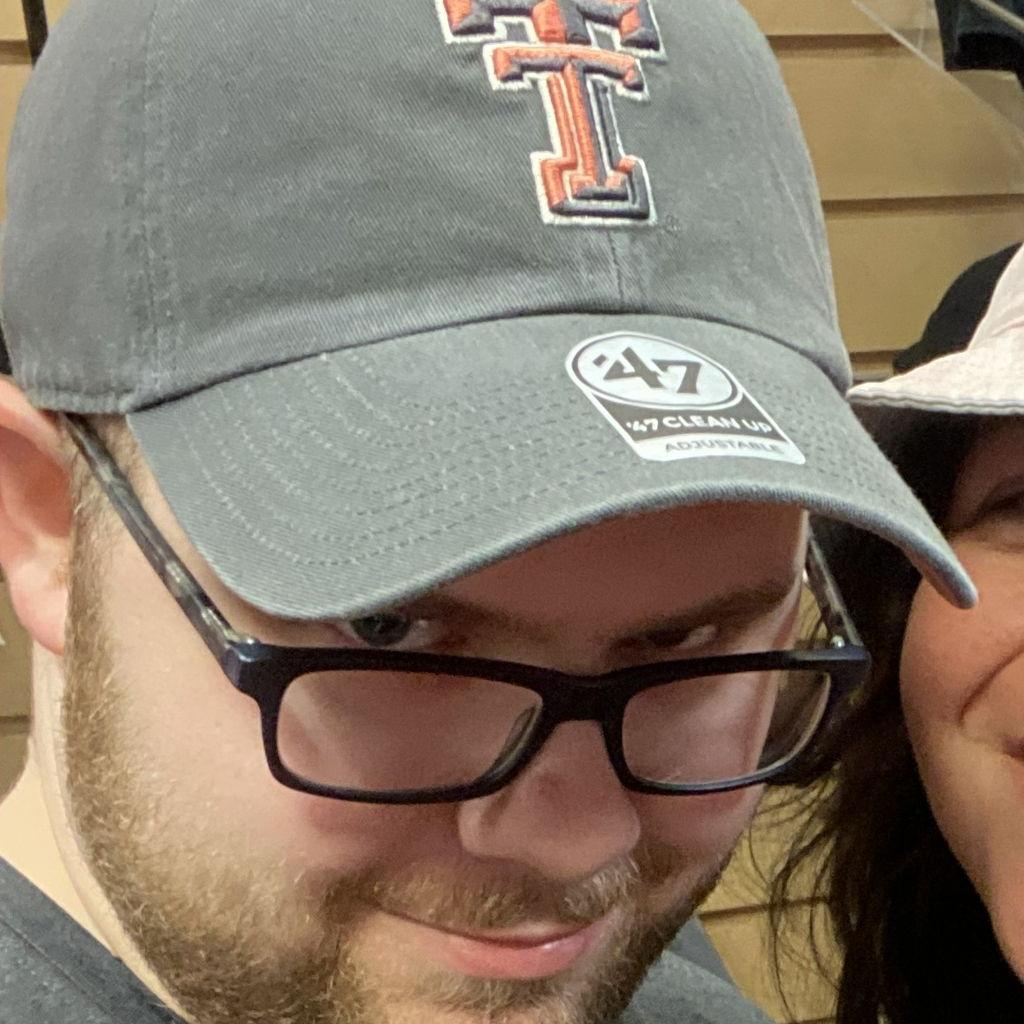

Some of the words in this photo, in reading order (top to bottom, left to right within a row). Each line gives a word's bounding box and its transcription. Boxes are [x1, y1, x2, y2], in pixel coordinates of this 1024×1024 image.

[593, 347, 701, 395] '47
[626, 417, 659, 433] '47
[662, 414, 740, 430] CLEAN
[742, 418, 773, 433] UP
[665, 438, 784, 456] ADJUSTABLE
